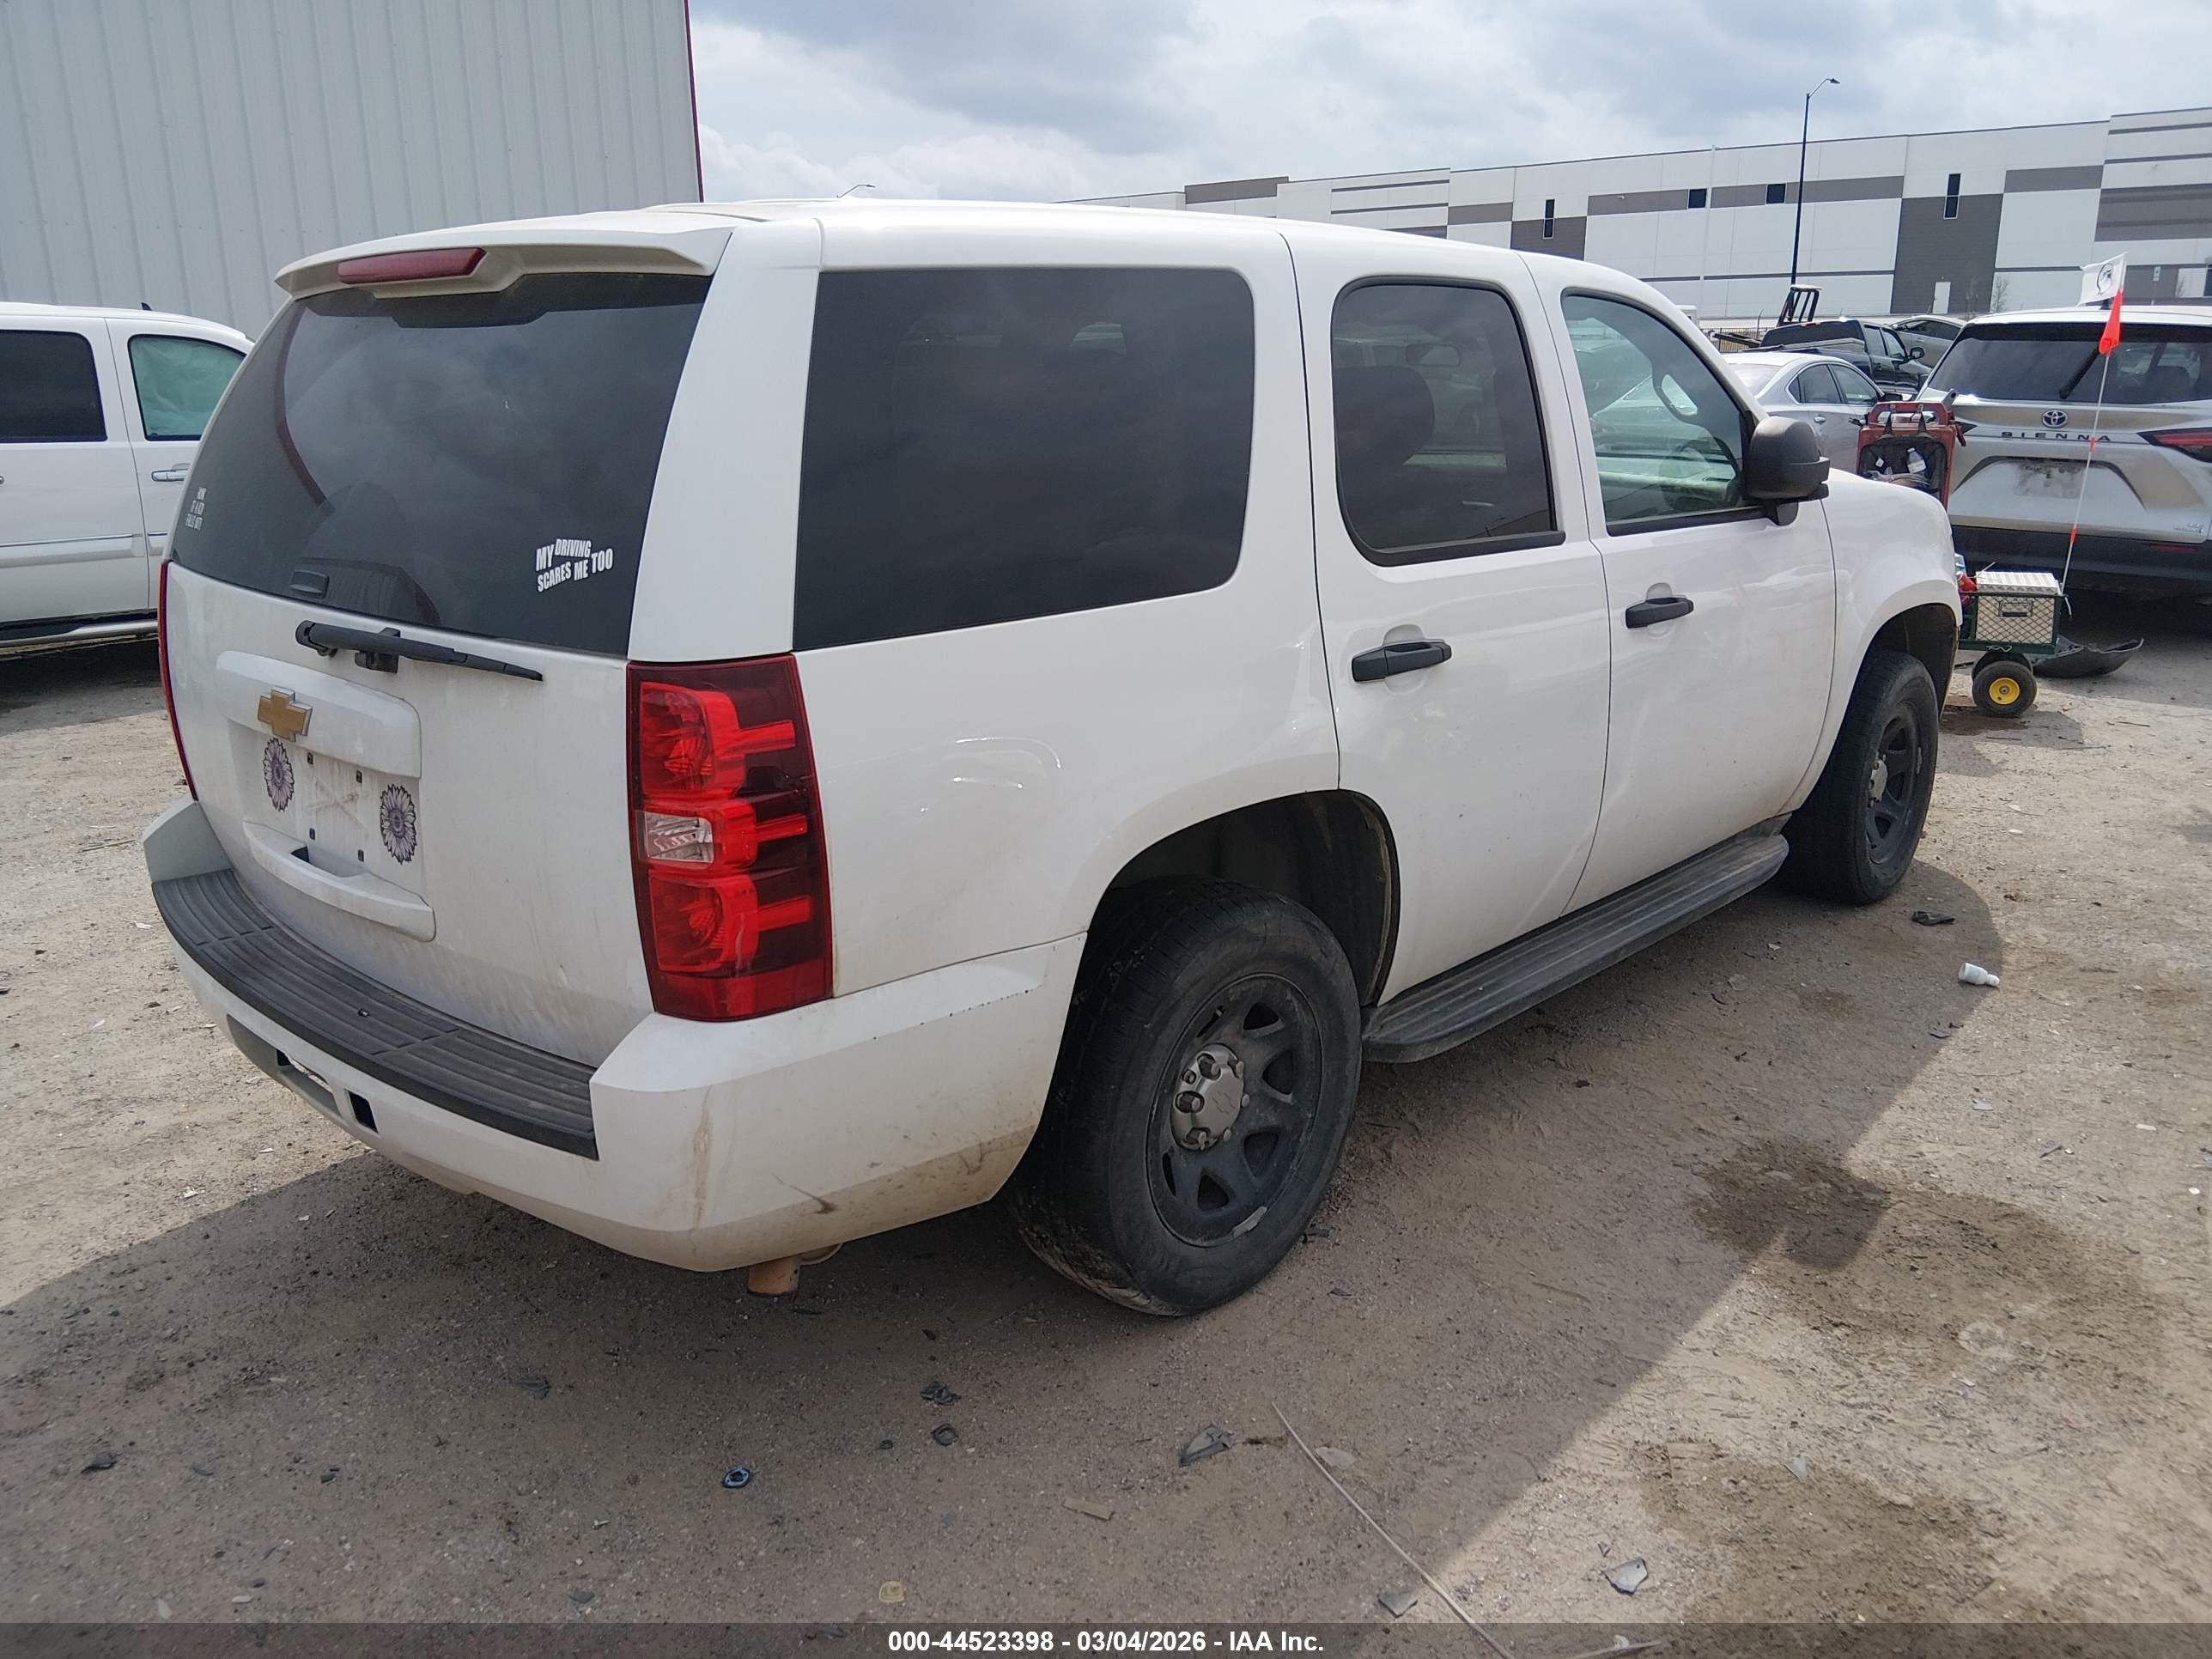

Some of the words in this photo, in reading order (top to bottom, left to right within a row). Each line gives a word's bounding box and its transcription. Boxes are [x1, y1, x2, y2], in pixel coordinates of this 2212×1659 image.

[2001, 431, 2111, 441] SIENNA
[536, 544, 555, 571] MY
[555, 538, 592, 558] DRIVING
[538, 561, 572, 592] SCARES
[574, 559, 589, 580] ME
[591, 548, 614, 574] TOO
